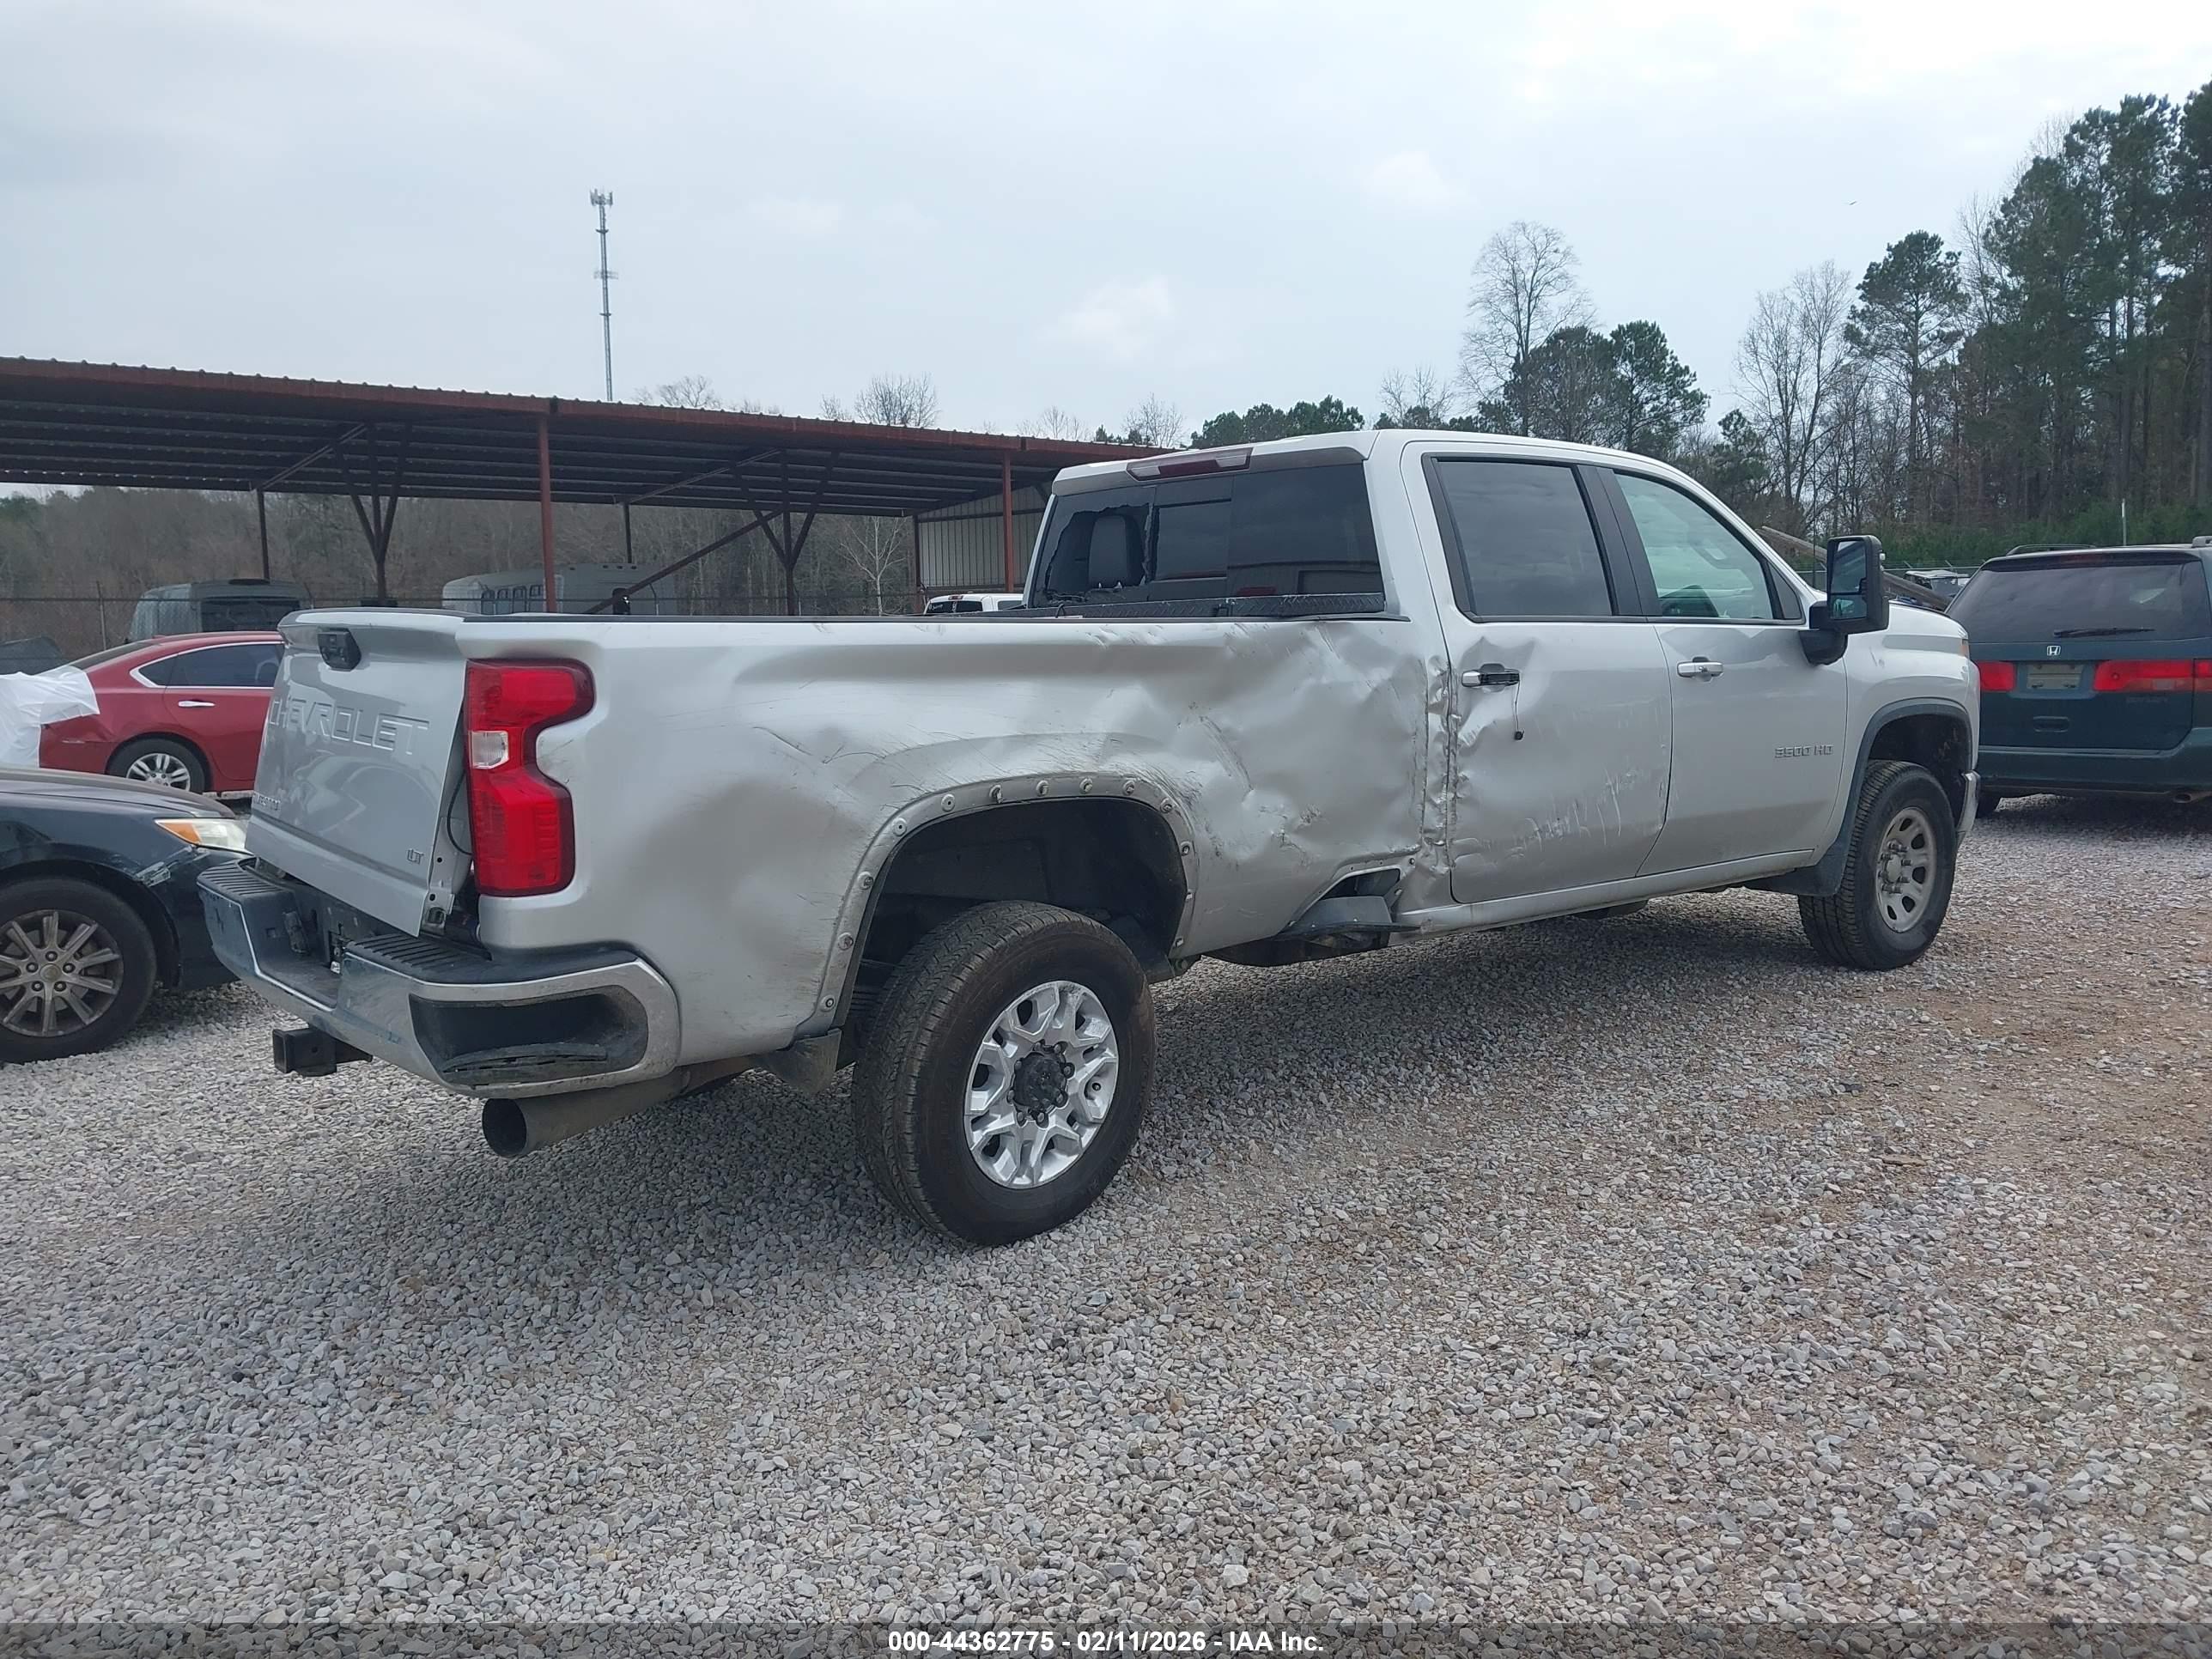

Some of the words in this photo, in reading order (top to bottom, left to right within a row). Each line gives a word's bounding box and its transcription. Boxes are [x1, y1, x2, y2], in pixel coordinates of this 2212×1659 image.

[269, 696, 429, 755] CHEVROLET
[1814, 744, 1834, 756] HD
[407, 848, 424, 865] LT
